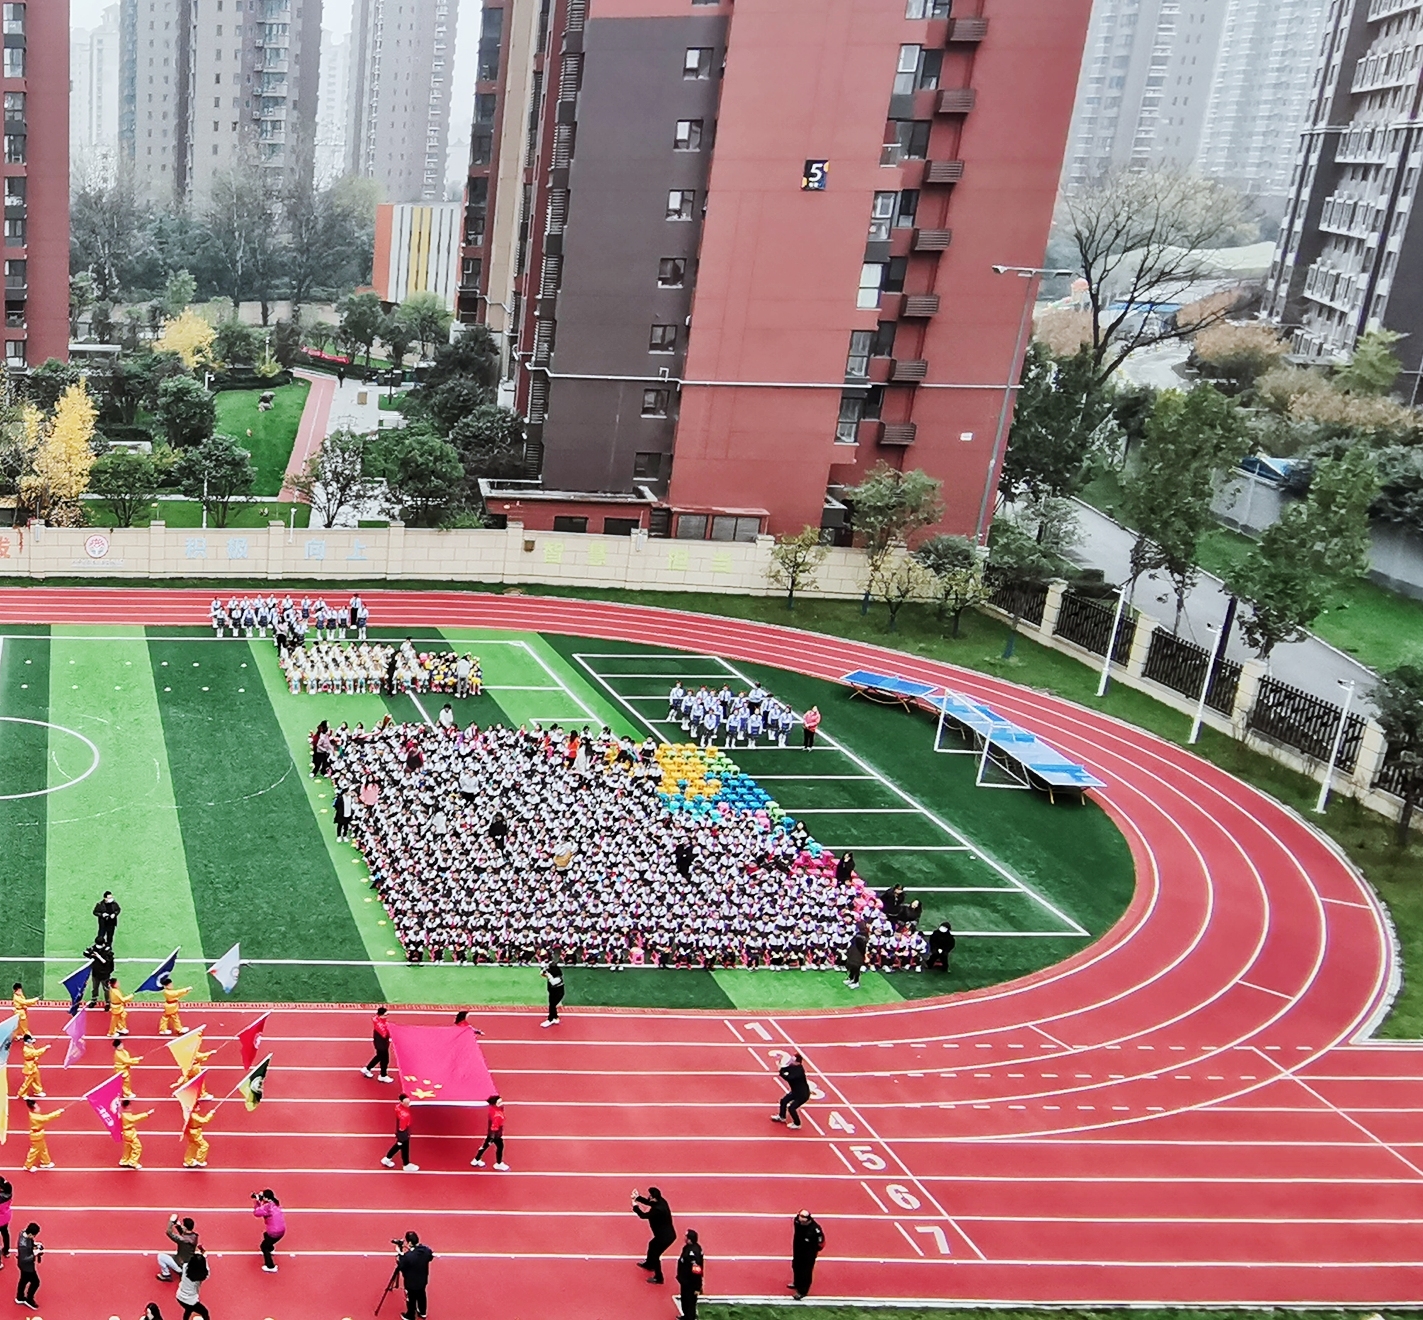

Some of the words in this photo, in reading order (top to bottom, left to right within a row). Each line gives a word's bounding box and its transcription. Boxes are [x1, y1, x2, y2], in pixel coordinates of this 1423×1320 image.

[808, 163, 823, 182] 5
[184, 537, 248, 559] 积极
[303, 538, 368, 561] 向上
[744, 1022, 772, 1040] 1
[828, 1111, 855, 1134] 4
[849, 1145, 886, 1170] 5
[886, 1184, 920, 1209] 6
[915, 1226, 951, 1254] 7
